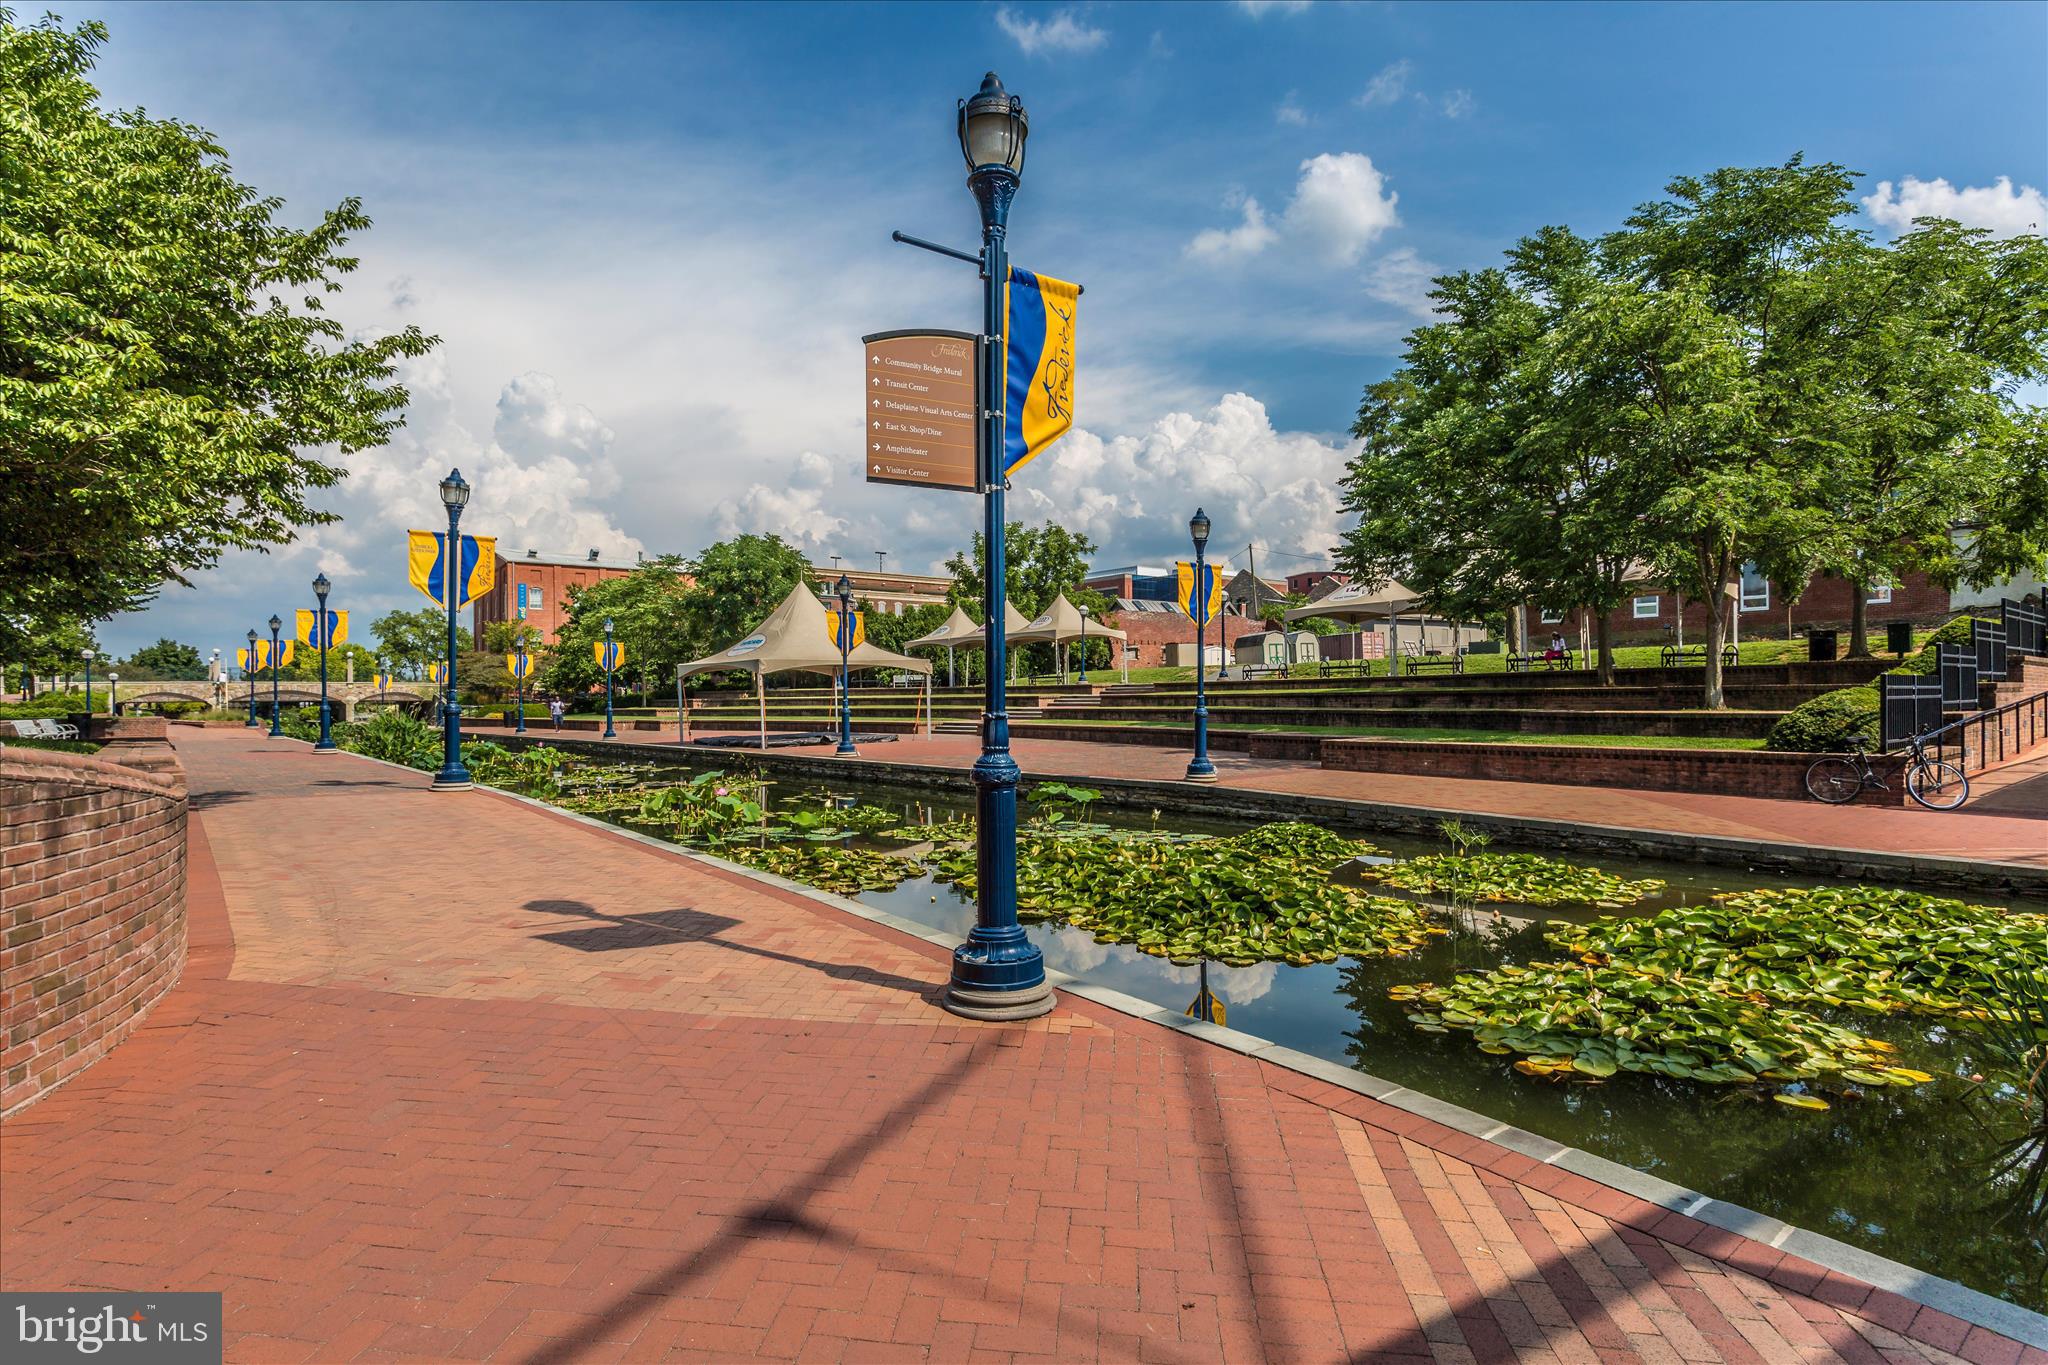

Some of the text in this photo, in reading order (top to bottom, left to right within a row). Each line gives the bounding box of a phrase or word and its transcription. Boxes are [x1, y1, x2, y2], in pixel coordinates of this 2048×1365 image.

[931, 343, 969, 360] Frederick
[885, 357, 962, 377] Community Bridge Mural
[1042, 301, 1072, 425] Frederick
[885, 379, 928, 392] Transit Center
[885, 400, 974, 420] Delaplaine Visual Arts Center
[885, 422, 943, 436] East St. Shop/Dine
[885, 444, 928, 456] Amphitheater
[886, 465, 929, 477] Visitor Center
